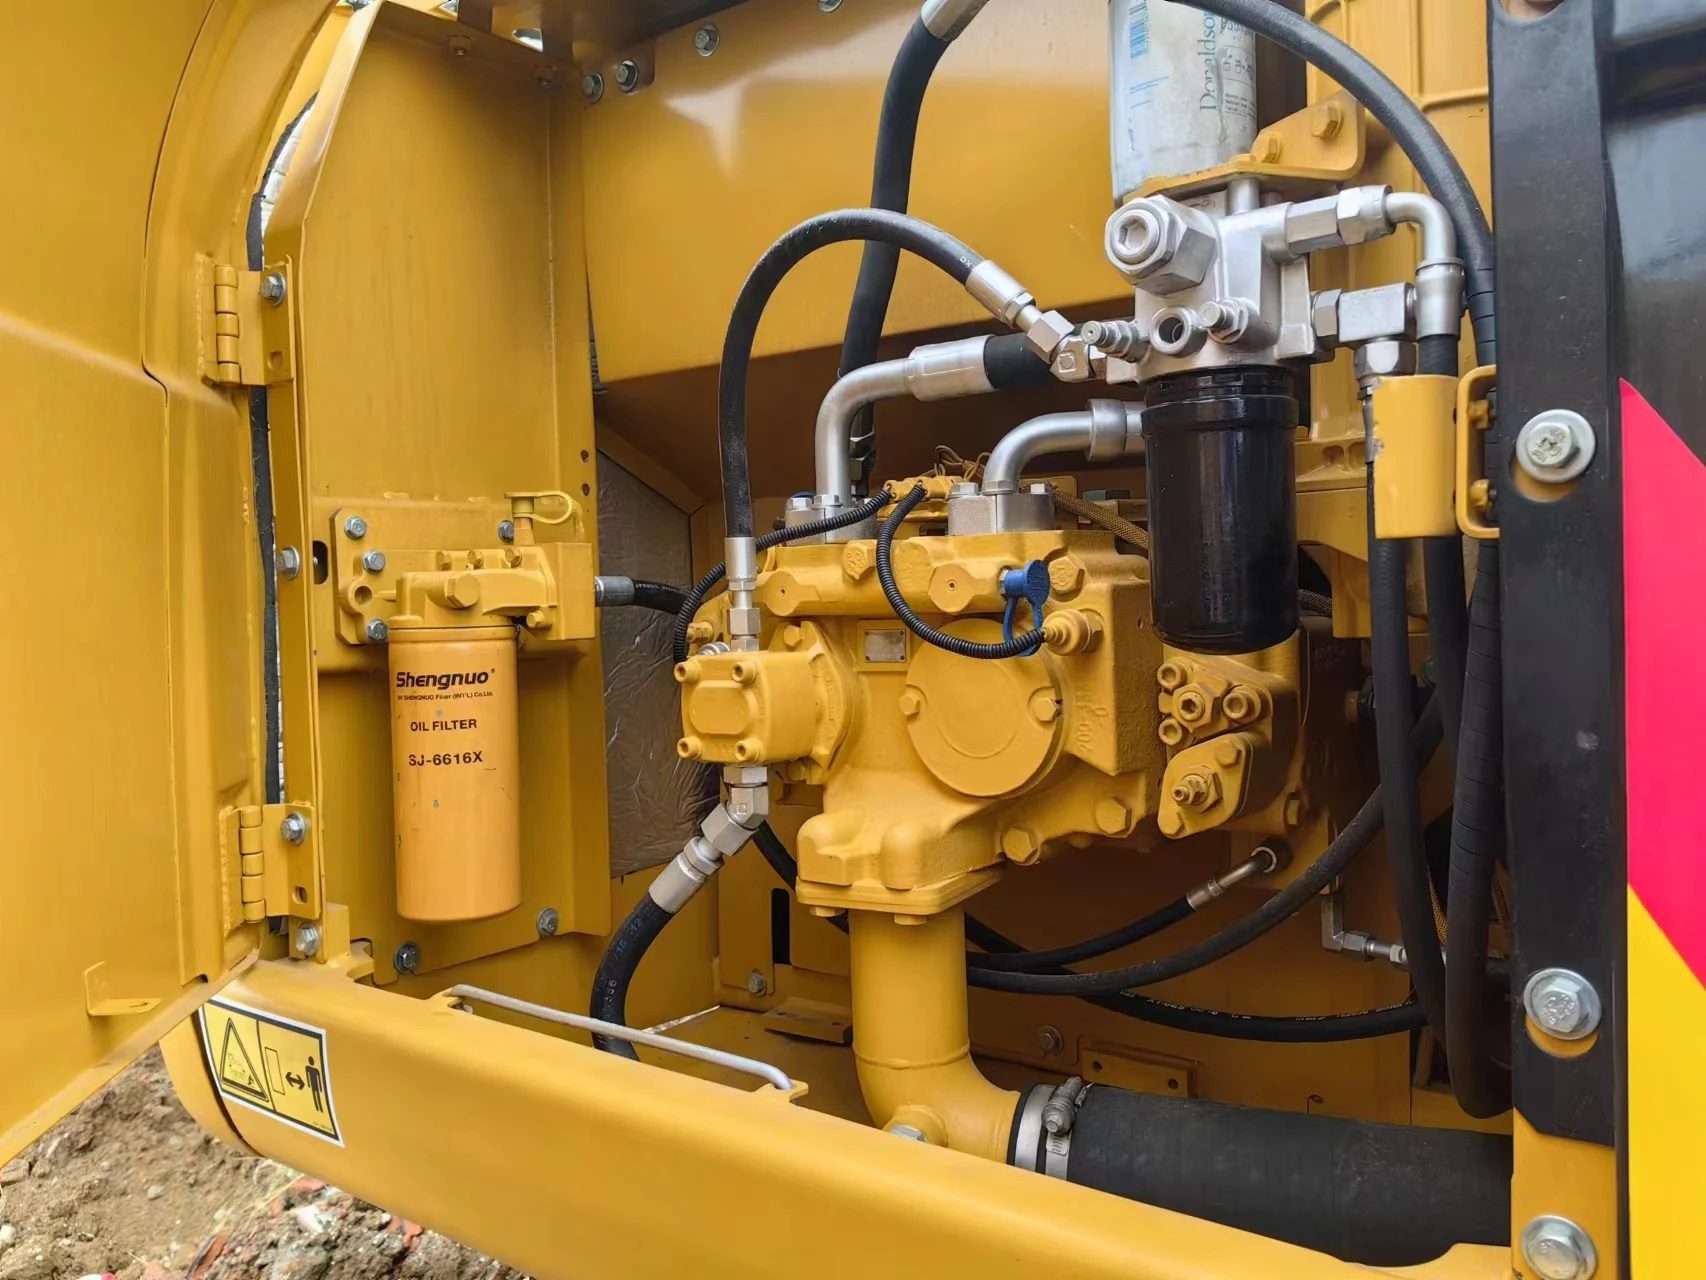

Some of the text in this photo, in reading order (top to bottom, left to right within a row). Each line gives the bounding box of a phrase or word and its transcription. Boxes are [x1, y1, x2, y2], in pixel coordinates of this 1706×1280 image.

[396, 671, 489, 690] Shengnuo
[410, 718, 478, 732] OIL FILTER
[408, 750, 484, 767] SJ-6616X
